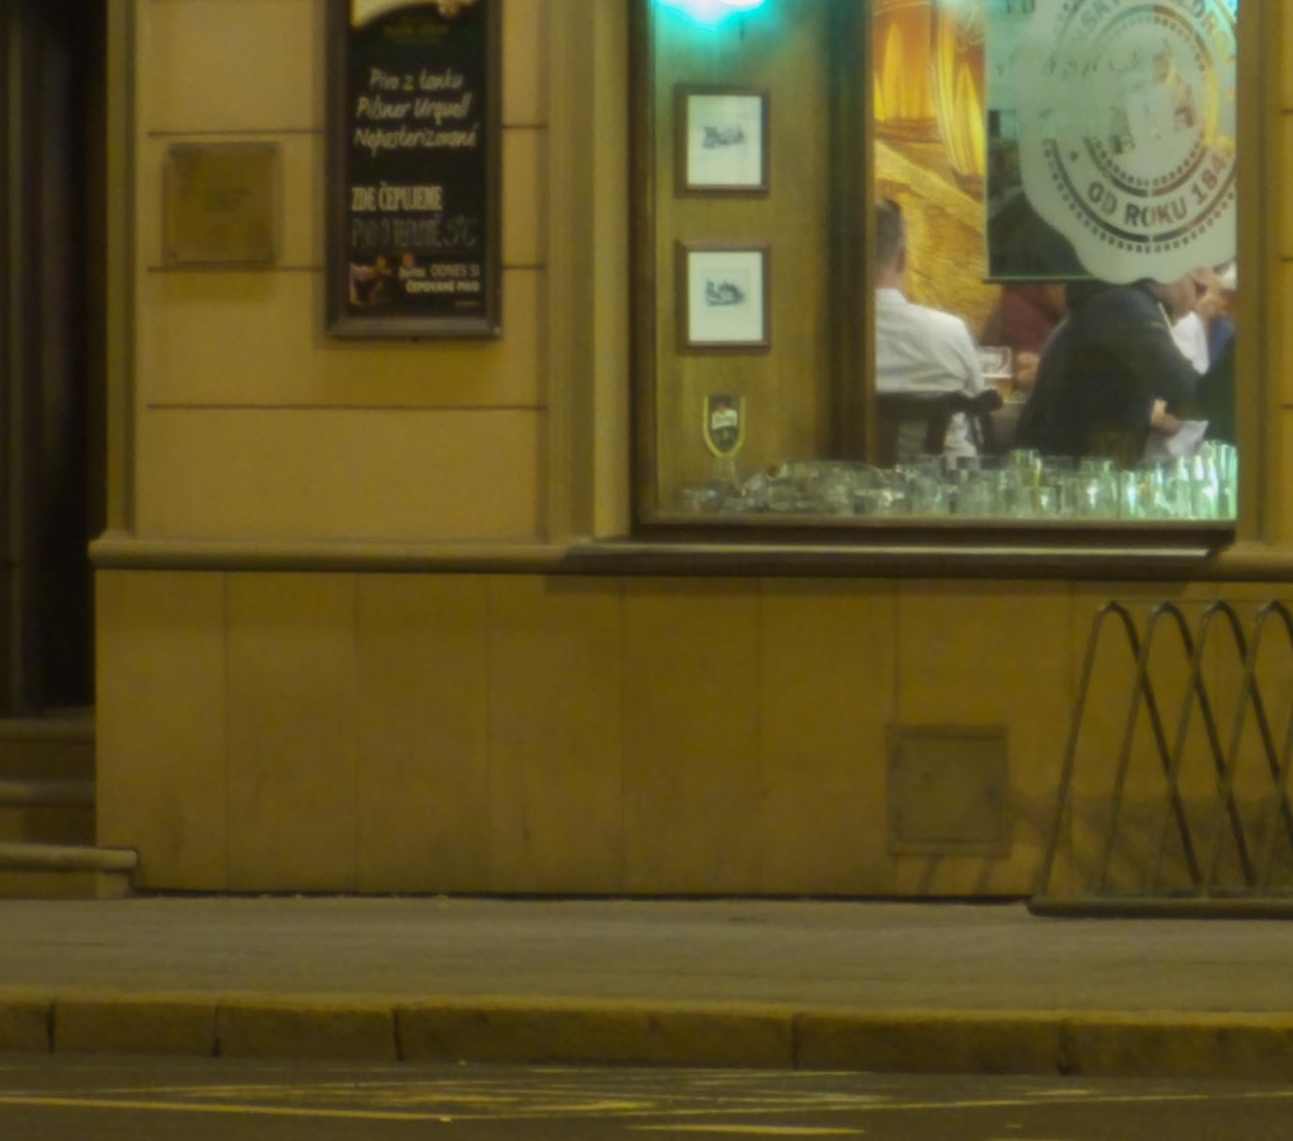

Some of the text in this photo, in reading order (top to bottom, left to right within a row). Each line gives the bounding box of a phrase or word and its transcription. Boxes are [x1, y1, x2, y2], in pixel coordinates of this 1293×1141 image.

[1087, 147, 1230, 228] OD ROKU 184
